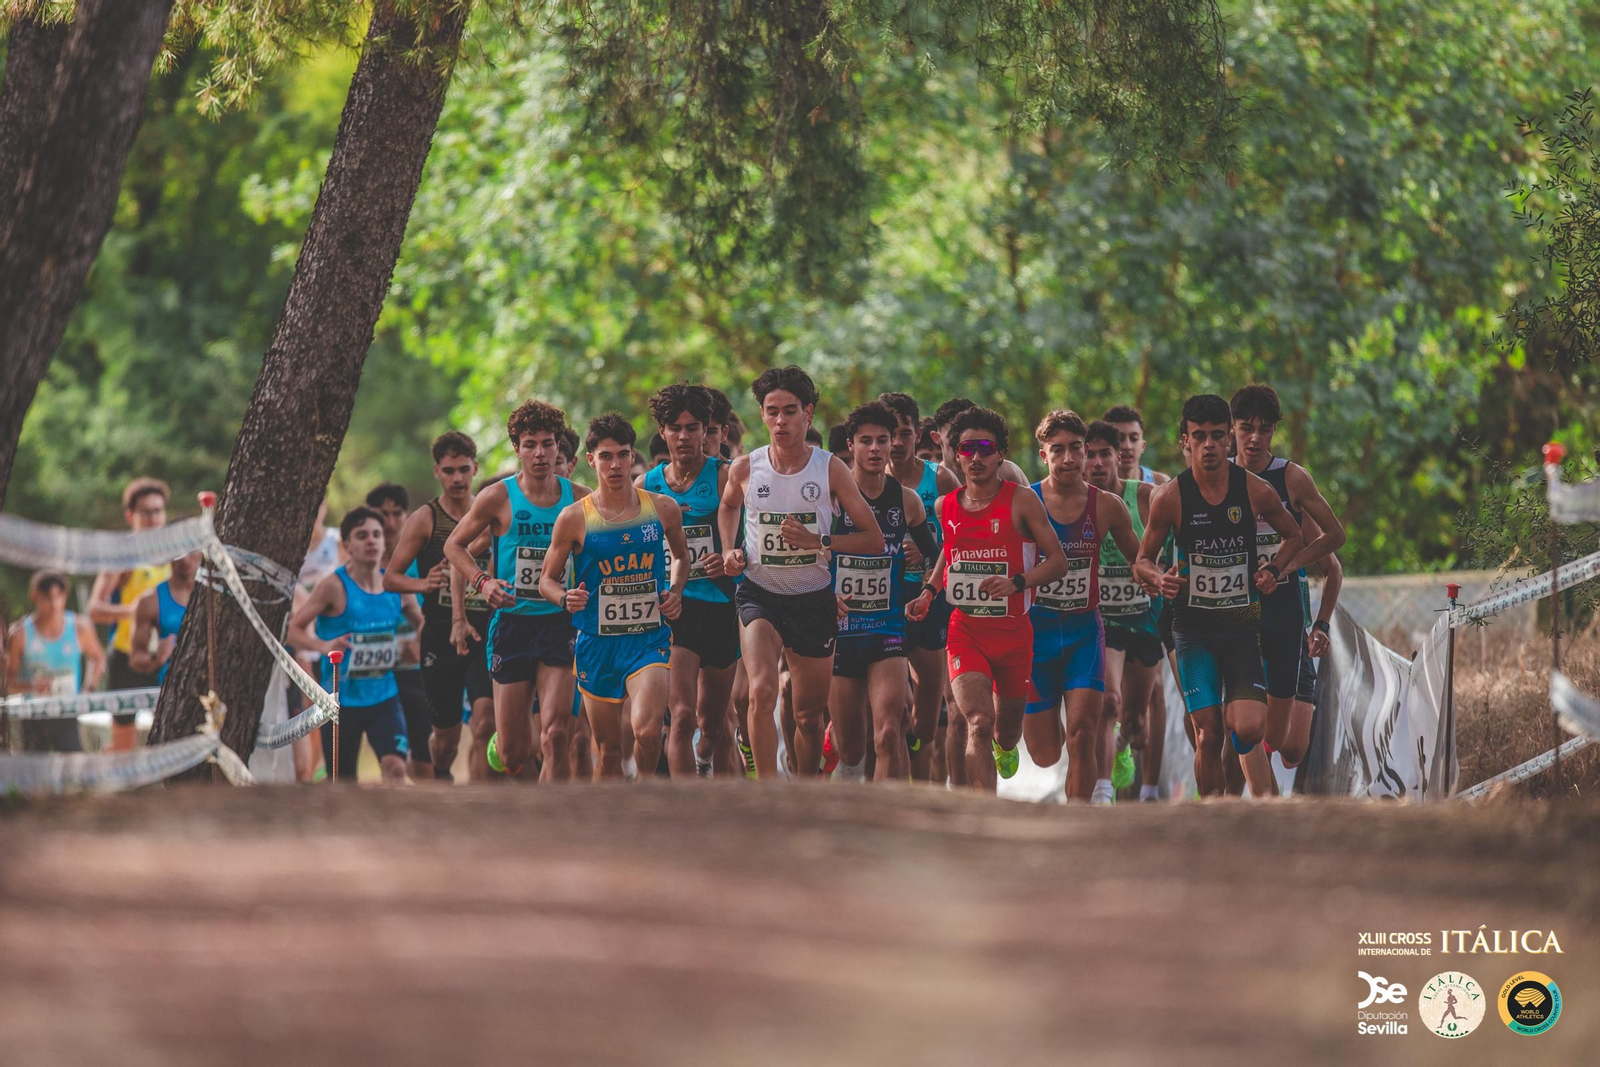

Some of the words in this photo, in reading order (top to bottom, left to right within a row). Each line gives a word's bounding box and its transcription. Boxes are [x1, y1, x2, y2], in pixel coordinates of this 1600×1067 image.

[764, 533, 801, 552] 61
[1195, 536, 1244, 550] PLAYAS
[855, 558, 880, 567] ITALICA
[962, 548, 1007, 559] navarra
[1205, 557, 1233, 565] ITALICA
[598, 552, 655, 576] UCAM
[520, 567, 567, 586] 822
[1196, 573, 1245, 594] 6124
[616, 585, 645, 593] ITALICA
[841, 576, 888, 597] 6156
[952, 582, 1004, 602] 616
[1100, 584, 1146, 602] 8294
[604, 600, 656, 621] 6157
[850, 623, 860, 631] DE
[861, 620, 888, 631] GALICIA
[353, 648, 393, 668] 8290
